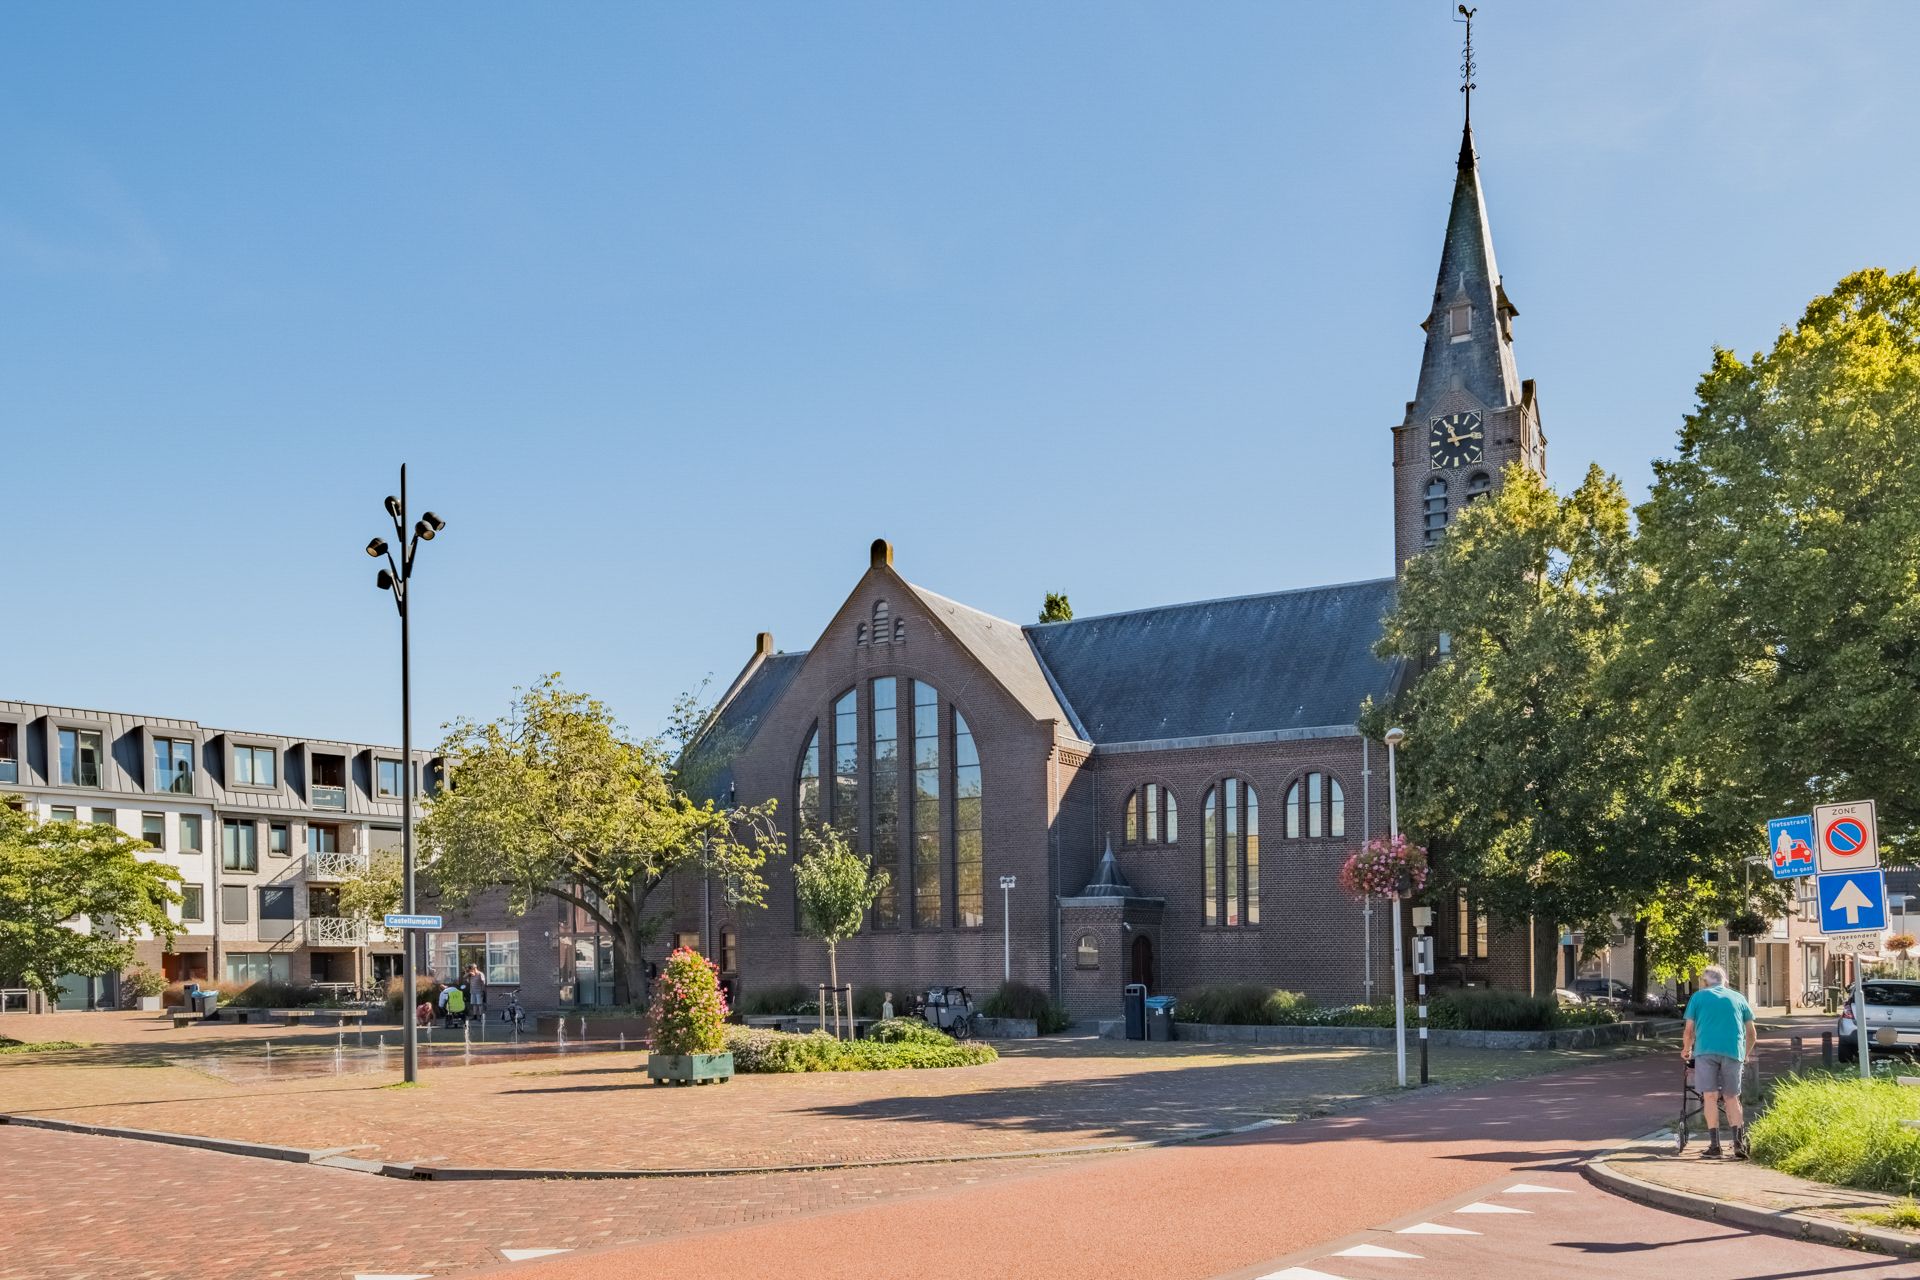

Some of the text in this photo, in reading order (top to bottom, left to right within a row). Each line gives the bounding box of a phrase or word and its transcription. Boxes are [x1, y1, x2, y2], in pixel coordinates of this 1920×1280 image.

[1831, 807, 1857, 815] ZONE
[1771, 819, 1808, 828] fietsstraat
[1799, 865, 1813, 873] gast
[389, 917, 438, 925] Castellumplein
[1832, 933, 1877, 941] uitgezonderd
